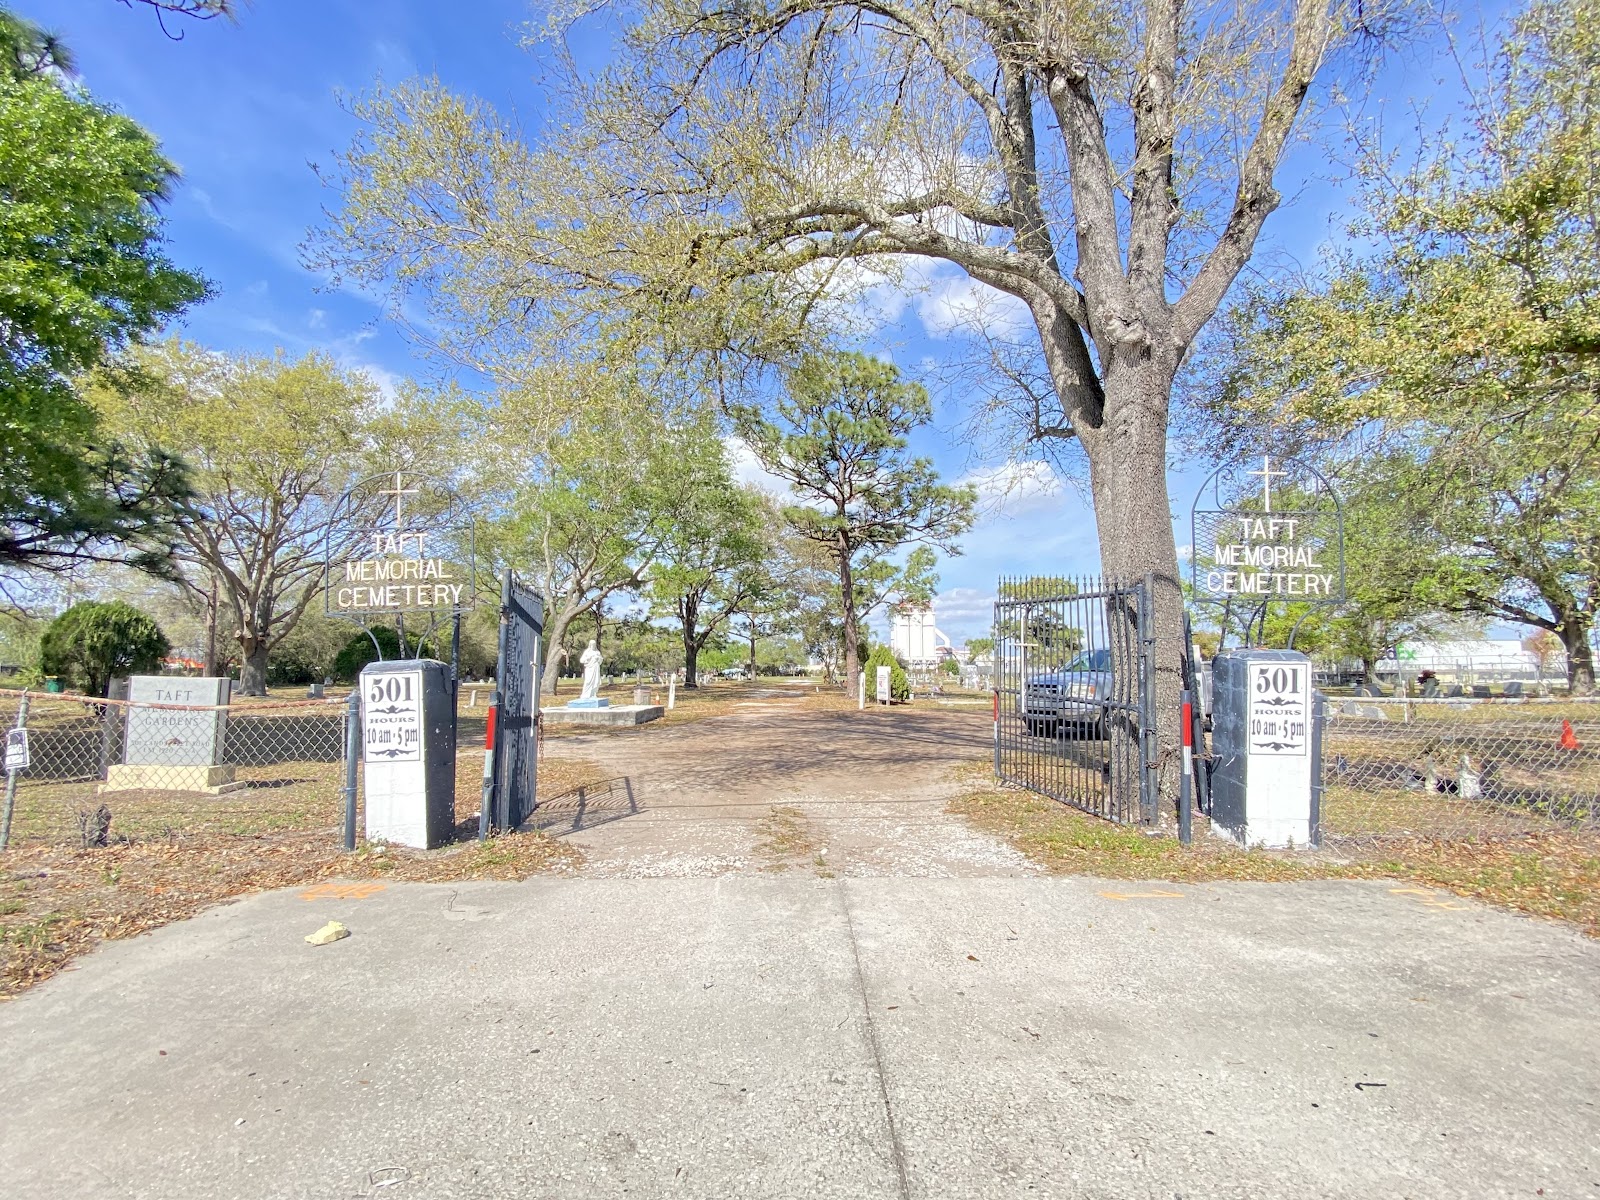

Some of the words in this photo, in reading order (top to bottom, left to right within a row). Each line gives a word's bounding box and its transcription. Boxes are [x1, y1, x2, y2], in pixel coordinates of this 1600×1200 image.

[1239, 518, 1299, 540] TAFT
[371, 533, 428, 553] TAFT
[1215, 545, 1322, 568] MEMORIAL
[346, 559, 452, 581] MEMORIAL
[1207, 572, 1333, 594] CEMETERY
[338, 584, 463, 607] CEMETERY
[1380, 643, 1417, 661] dEx
[371, 677, 414, 703] 501
[1256, 668, 1300, 694] 501
[156, 690, 192, 701] TAFT
[145, 717, 199, 726] GARDENS
[1251, 719, 1262, 736] 10
[1263, 721, 1277, 736] am
[1283, 720, 1288, 739] 5
[1290, 721, 1304, 741] pm
[367, 728, 377, 744] 10
[378, 729, 391, 744] am
[398, 727, 403, 745] 5
[405, 728, 418, 747] pm
